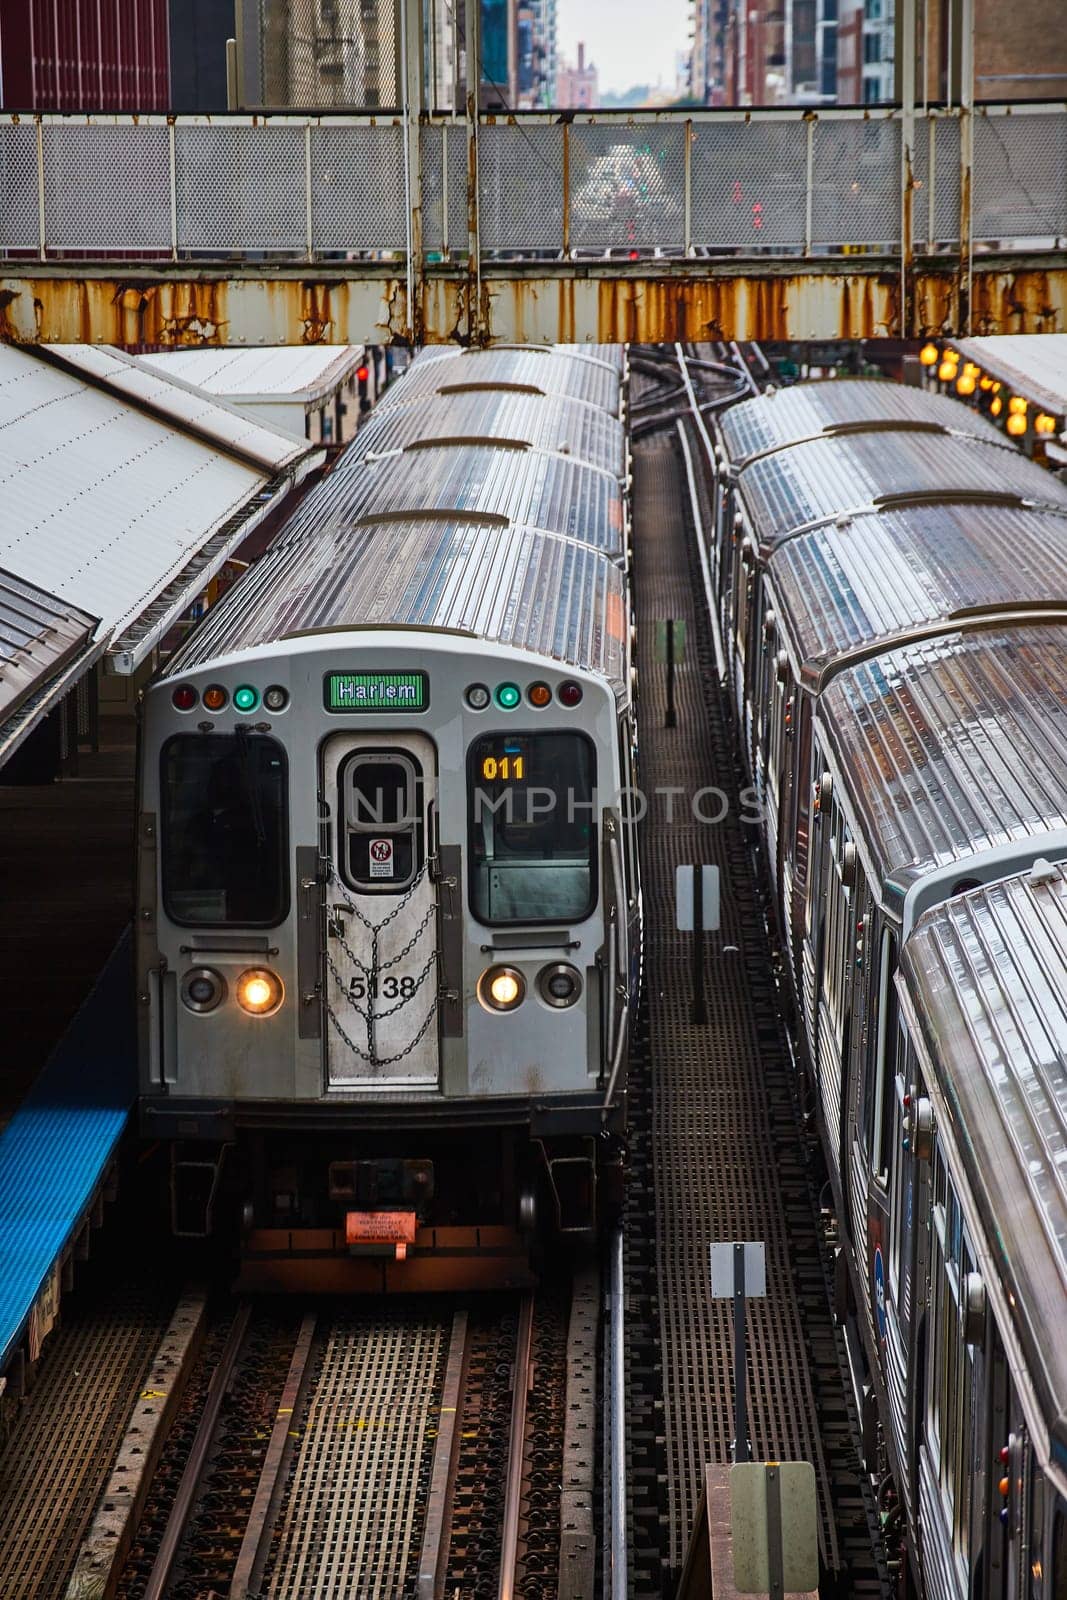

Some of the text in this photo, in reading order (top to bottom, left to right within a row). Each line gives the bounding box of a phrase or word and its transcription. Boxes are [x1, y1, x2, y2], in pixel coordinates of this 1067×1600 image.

[339, 681, 416, 699] Harlem
[483, 757, 524, 779] 011
[349, 976, 416, 999] 5138
